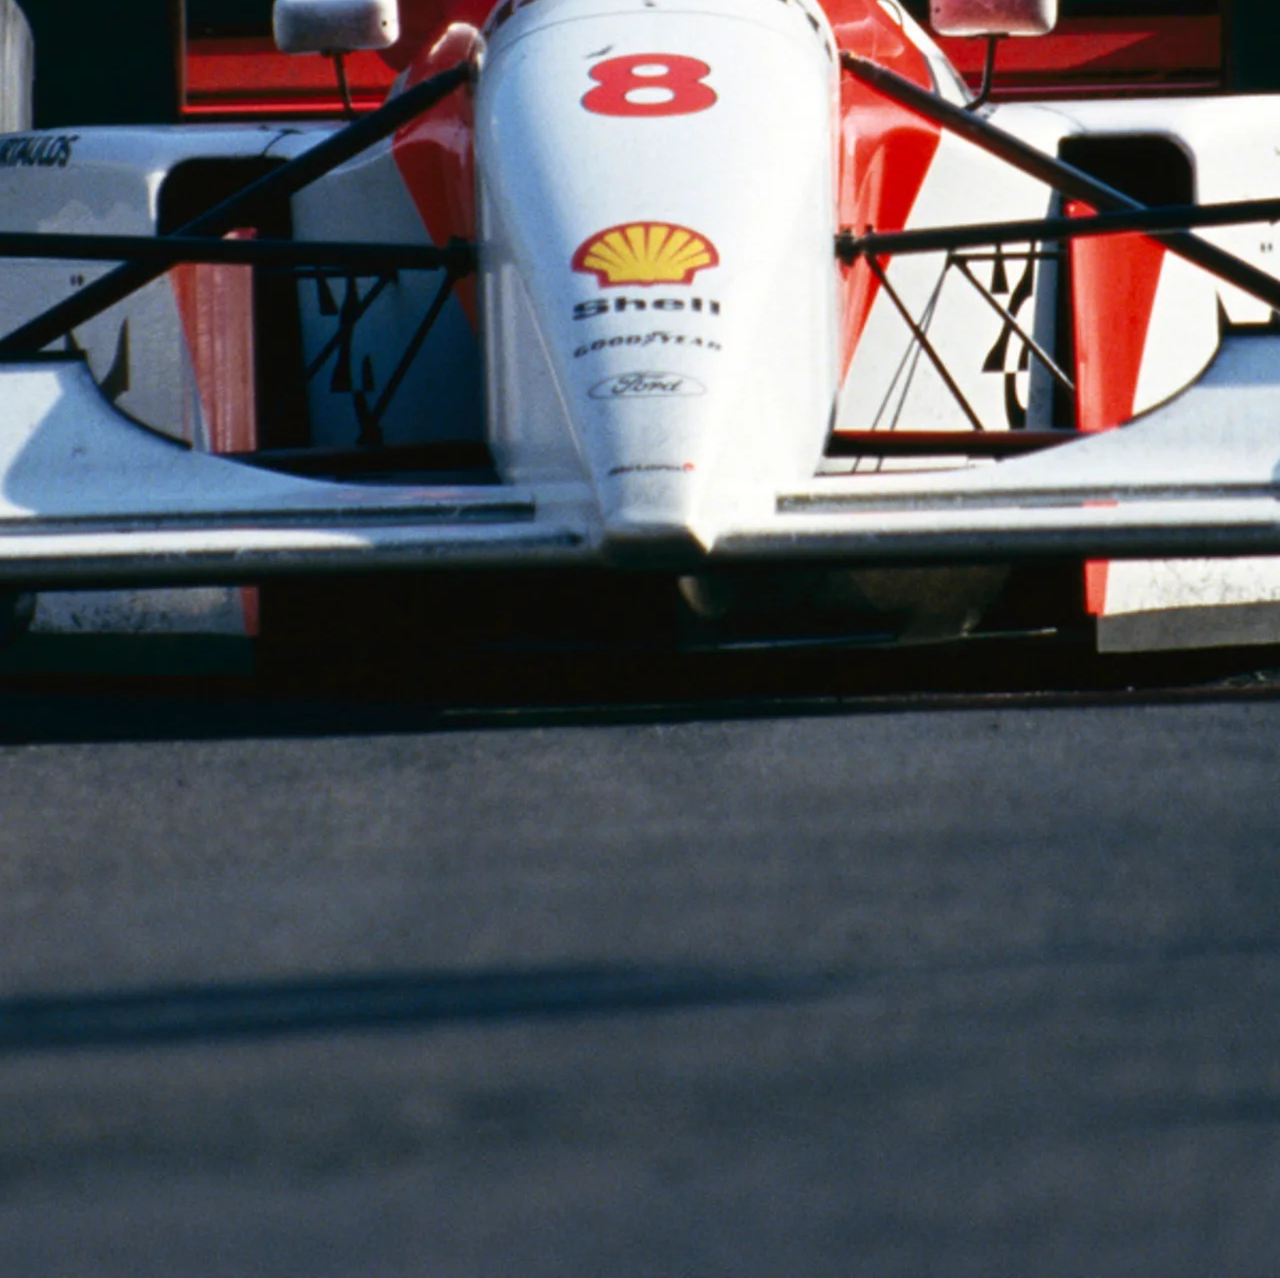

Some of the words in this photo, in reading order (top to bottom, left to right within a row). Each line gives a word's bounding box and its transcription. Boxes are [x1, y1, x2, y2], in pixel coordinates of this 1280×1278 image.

[581, 53, 718, 118] 8
[572, 296, 721, 321] Shell
[611, 372, 683, 395] Ford
